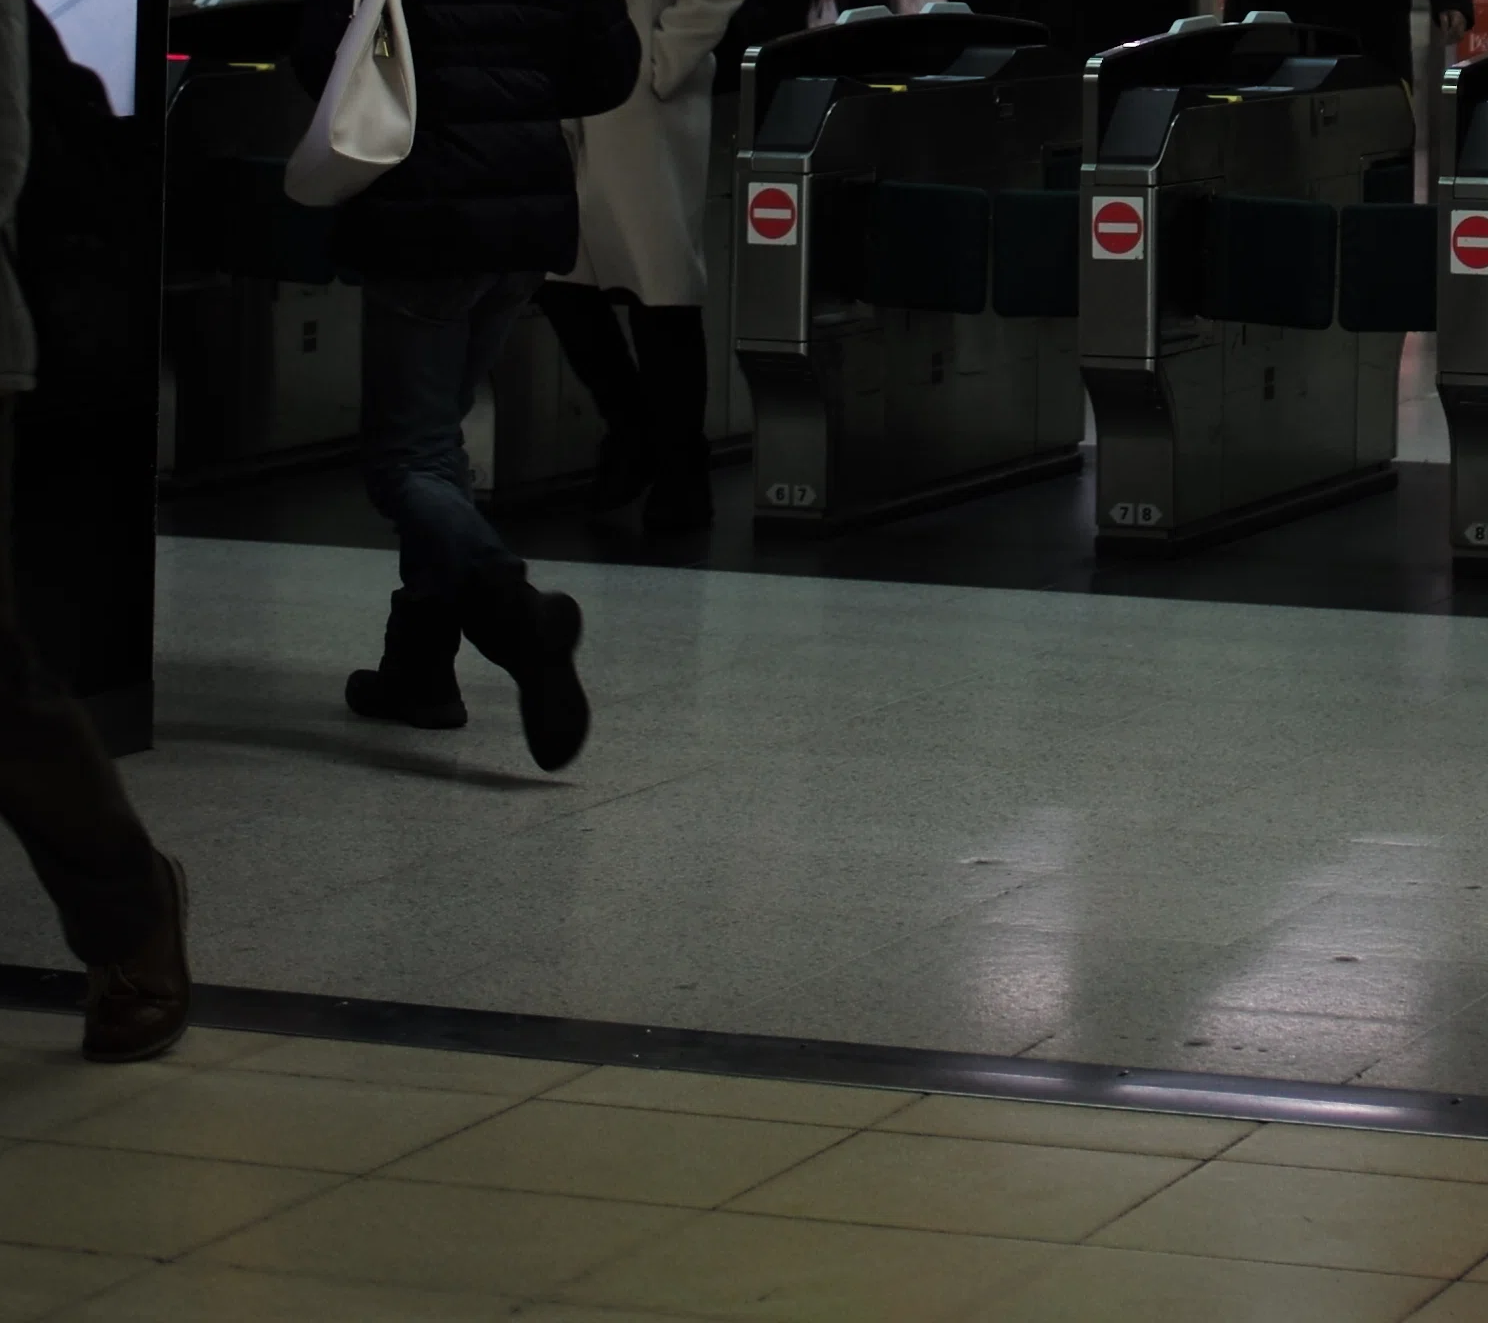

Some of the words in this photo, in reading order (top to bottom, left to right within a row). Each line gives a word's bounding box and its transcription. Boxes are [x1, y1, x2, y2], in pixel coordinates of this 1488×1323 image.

[775, 487, 785, 501] 6
[797, 488, 807, 502] 7
[1119, 507, 1129, 521] 7
[1142, 508, 1152, 521] 8
[1475, 526, 1484, 540] 8
